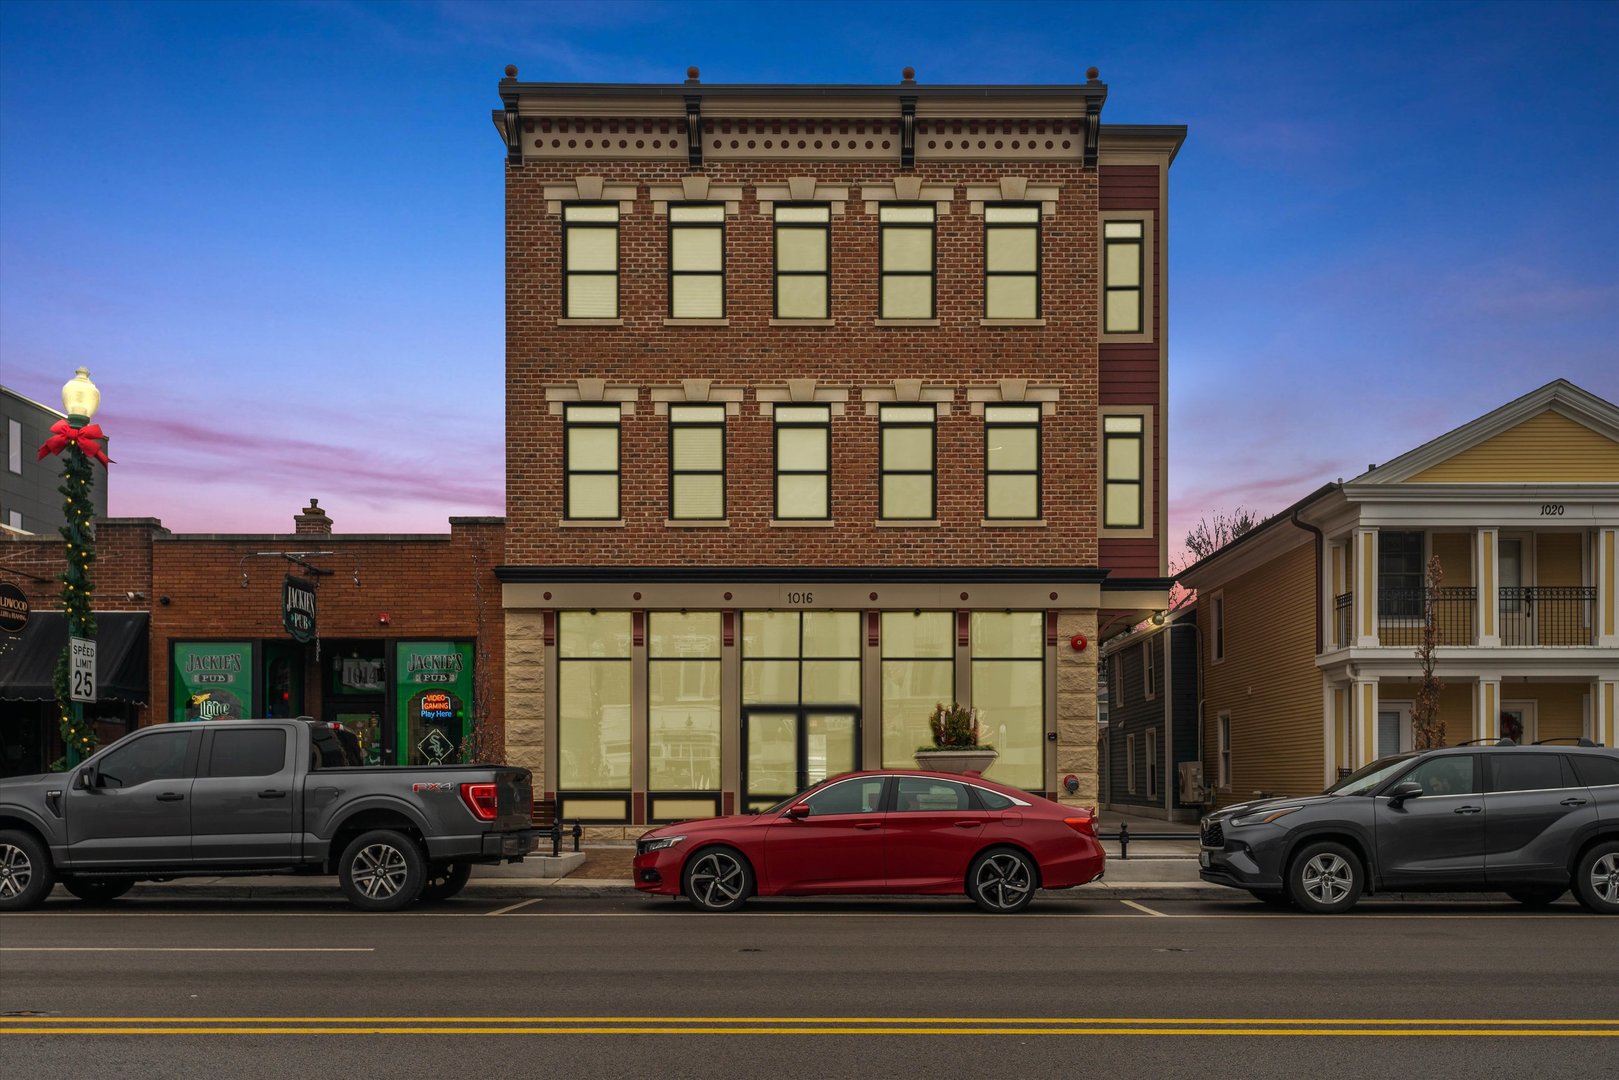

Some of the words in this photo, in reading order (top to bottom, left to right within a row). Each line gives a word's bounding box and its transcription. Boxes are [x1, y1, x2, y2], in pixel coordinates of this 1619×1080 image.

[1540, 504, 1565, 516] 1020
[787, 592, 813, 604] 1016
[294, 612, 308, 630] PUB
[73, 644, 95, 658] SPEED
[75, 658, 92, 669] LIMIT
[185, 653, 242, 673] JACKIE'S
[407, 653, 464, 673] JACKIE'S
[74, 670, 93, 697] 25
[201, 674, 226, 682] PUB
[423, 674, 448, 682] PUB
[426, 694, 446, 702] VIDEO
[423, 702, 449, 710] GAMING
[421, 710, 435, 719] Play
[436, 710, 453, 718] Here
[412, 782, 455, 793] FX4
